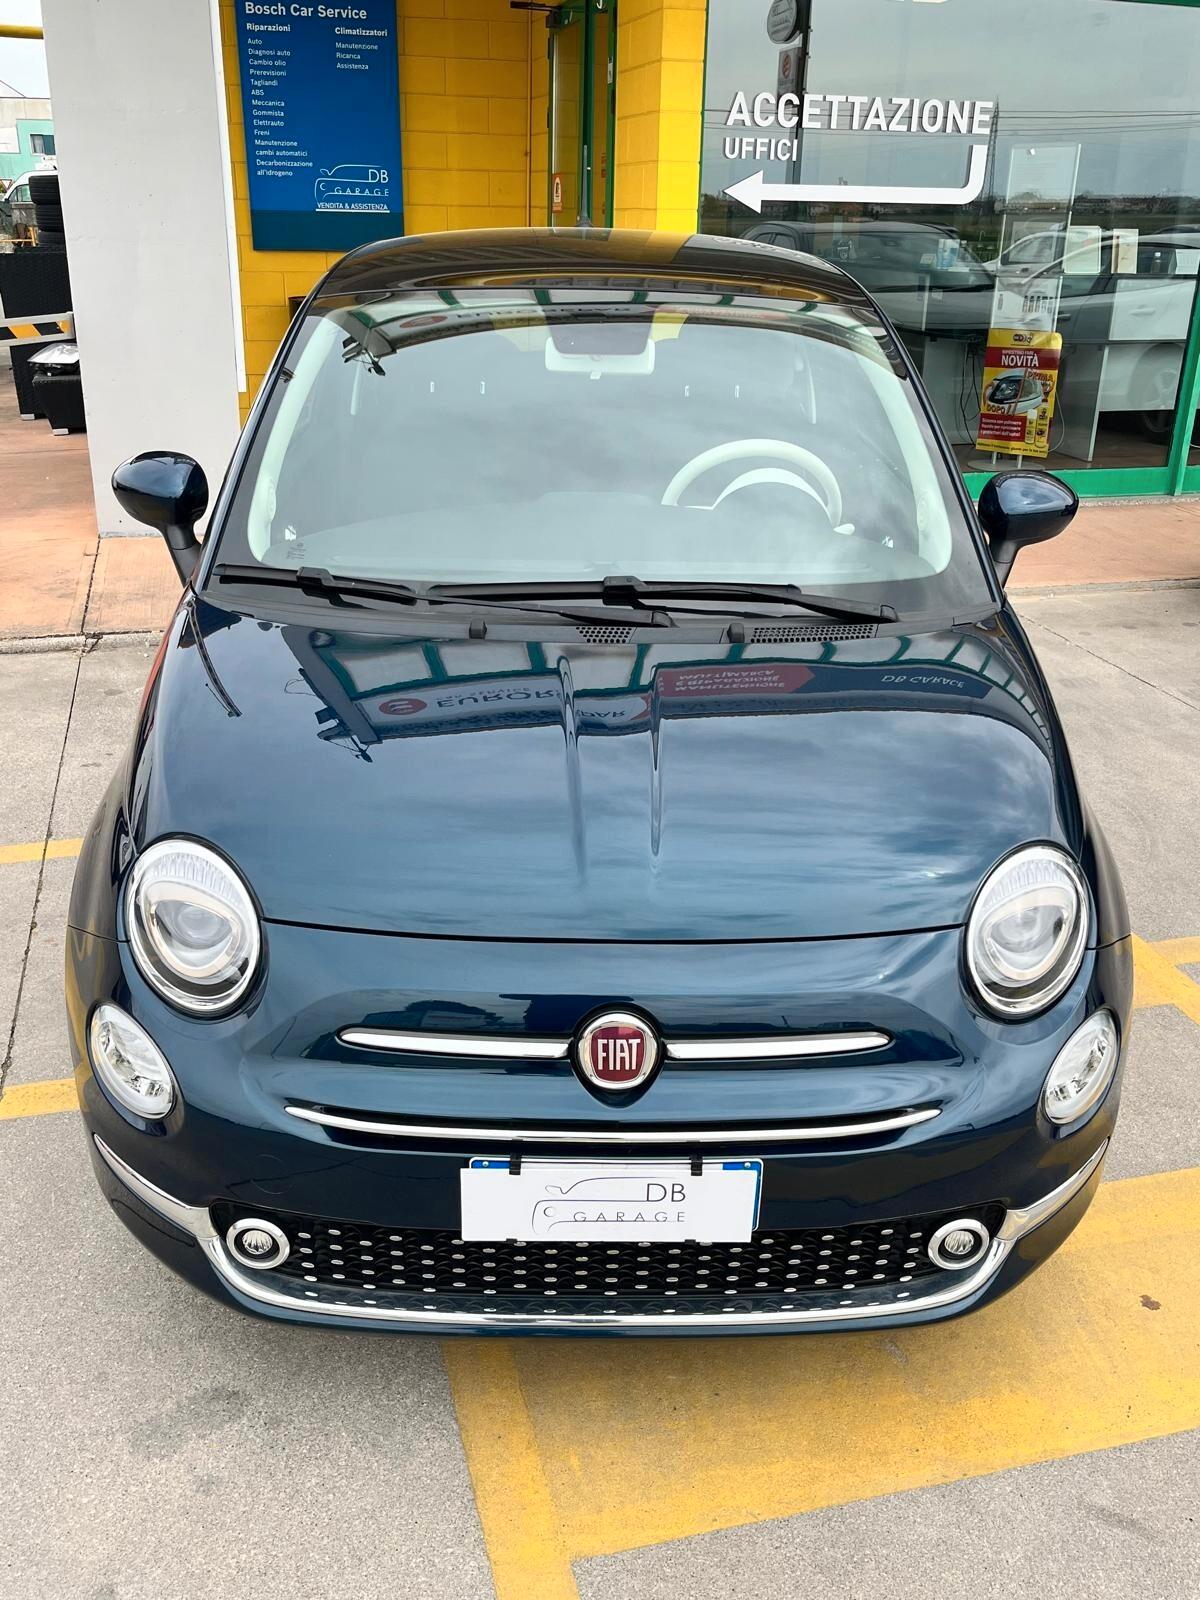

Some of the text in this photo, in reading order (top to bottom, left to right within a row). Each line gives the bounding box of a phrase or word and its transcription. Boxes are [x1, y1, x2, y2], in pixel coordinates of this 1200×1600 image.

[244, 1, 367, 19] Bosch Car Service
[246, 23, 291, 33] Riparazioni
[335, 27, 388, 37] Climatizzatori
[335, 42, 379, 50] Manutenzione
[248, 48, 276, 57] Diagnosi
[249, 58, 273, 66] Cambio
[336, 62, 369, 70] Assistenza
[249, 68, 287, 77] Prerevisioni
[250, 78, 278, 87] Tagliandi
[252, 99, 285, 107] Meccanica
[252, 109, 285, 117] Gommista
[725, 91, 994, 135] ACCETTAZIONE
[253, 119, 285, 127] Elettrauto
[254, 139, 298, 147] Manutenzione
[275, 149, 308, 157] automatici
[723, 136, 798, 162] UFFICI
[256, 159, 313, 168] Decarbonizzazione
[256, 169, 293, 177] all'idrogeno
[368, 169, 389, 183] DB
[334, 187, 389, 196] GARAGE
[317, 202, 344, 210] VENDITA
[350, 203, 388, 211] ASSISTENZA
[1001, 353, 1039, 367] NOVITÀ
[597, 1038, 641, 1071] FIAT
[646, 1183, 686, 1203] DB
[573, 1211, 685, 1223] GARAGE
